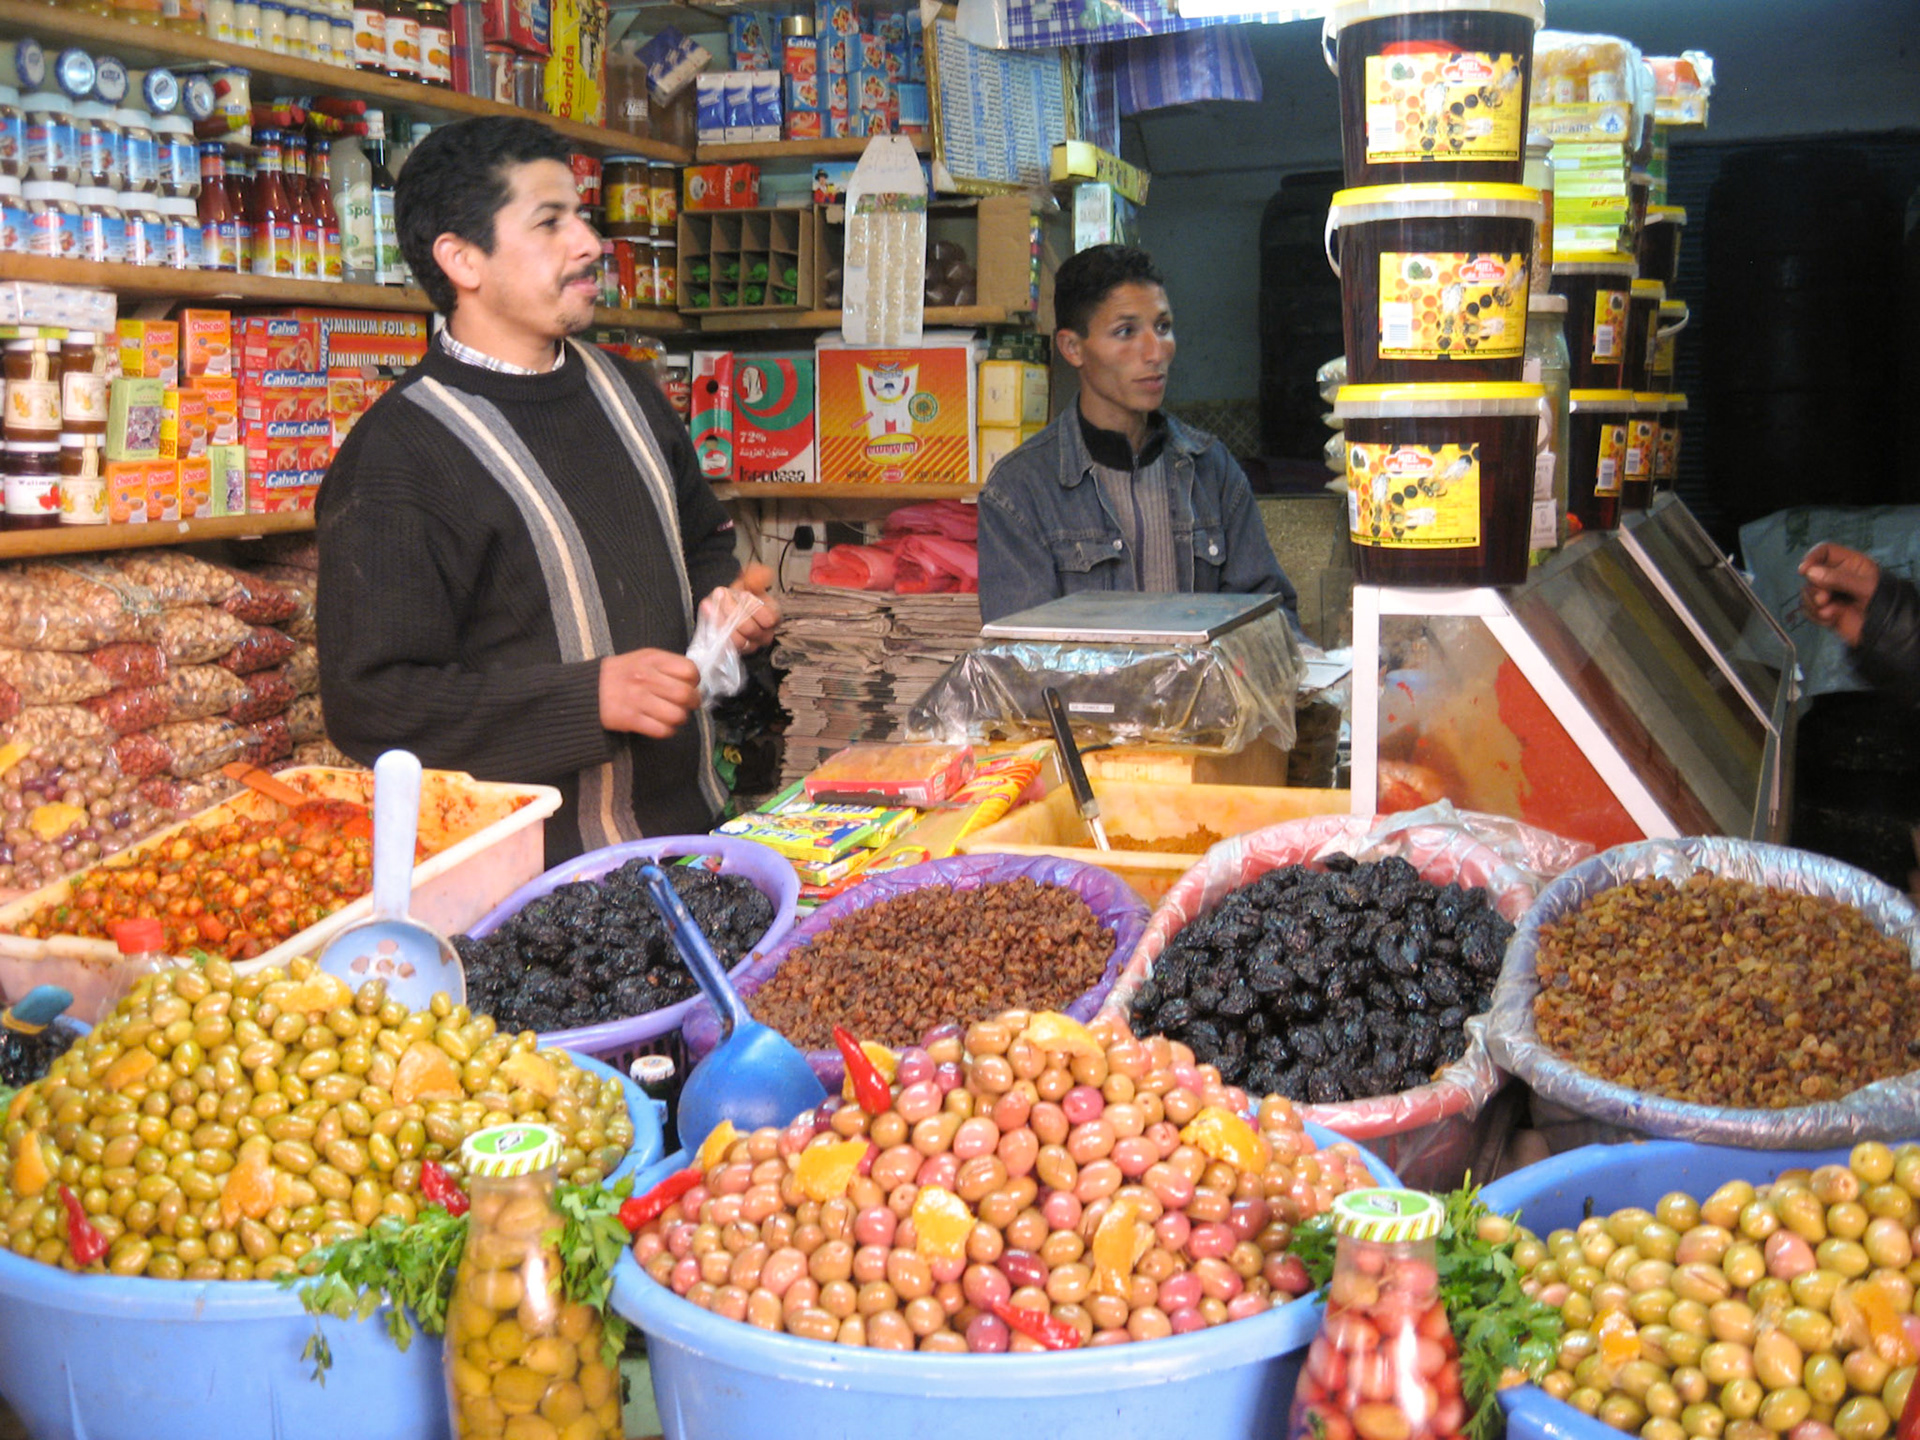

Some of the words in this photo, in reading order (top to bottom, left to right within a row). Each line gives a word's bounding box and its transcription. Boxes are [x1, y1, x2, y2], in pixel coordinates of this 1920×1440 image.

[560, 45, 574, 118] Borida
[1475, 262, 1493, 272] MIEL
[192, 321, 225, 331] Chocao
[268, 321, 298, 335] Calvo
[382, 320, 406, 336] FOIL
[410, 322, 417, 337] 8
[320, 324, 330, 370] Calvo
[383, 354, 405, 367] FOIL
[264, 373, 297, 386] Calvo
[298, 373, 326, 386] Calvo
[268, 423, 298, 435] Calvo
[301, 422, 328, 435] Calvo
[268, 474, 298, 487] Calvo
[300, 472, 323, 485] Calv
